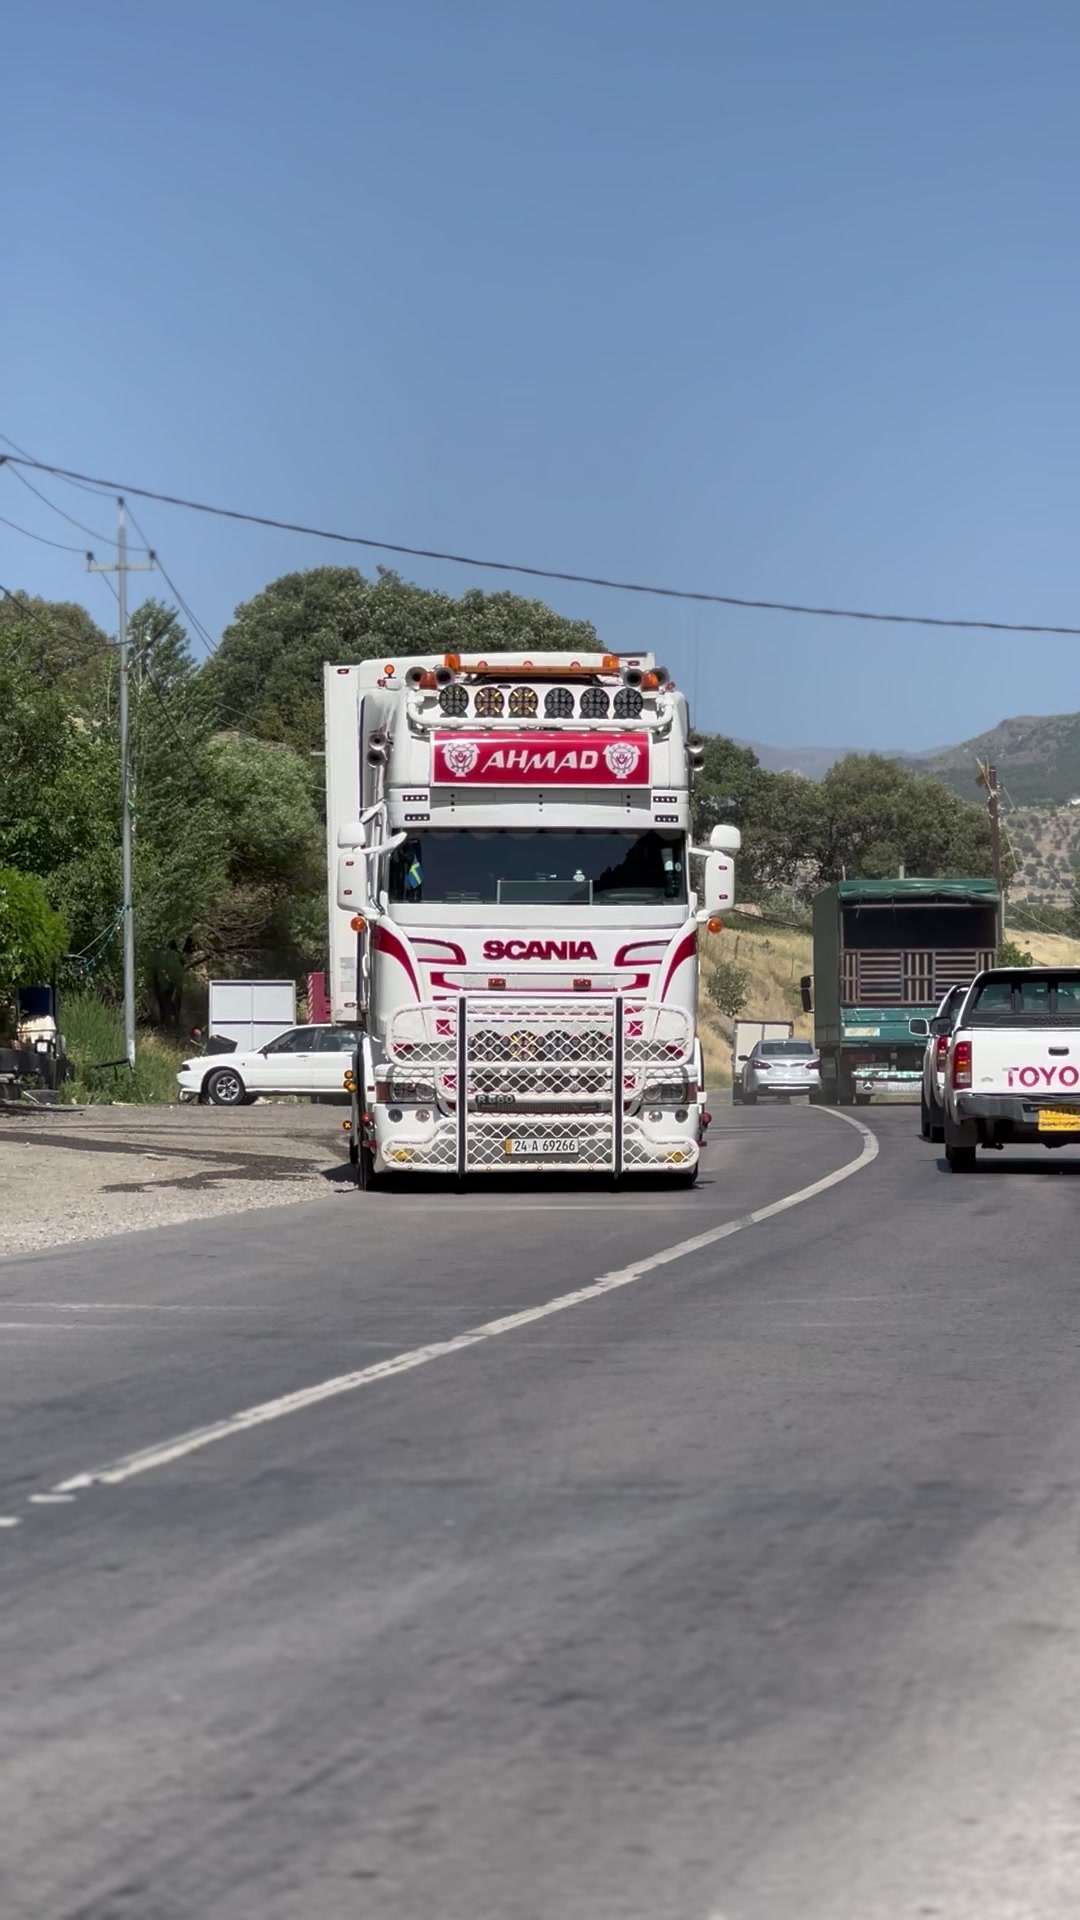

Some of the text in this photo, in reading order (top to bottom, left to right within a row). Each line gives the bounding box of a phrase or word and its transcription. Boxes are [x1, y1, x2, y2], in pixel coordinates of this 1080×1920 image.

[481, 750, 598, 773] AHMAD
[483, 940, 598, 960] SCANIA
[477, 1095, 487, 1104] R
[514, 1140, 527, 1152] 24
[531, 1140, 539, 1152] A
[542, 1140, 576, 1152] 69266
